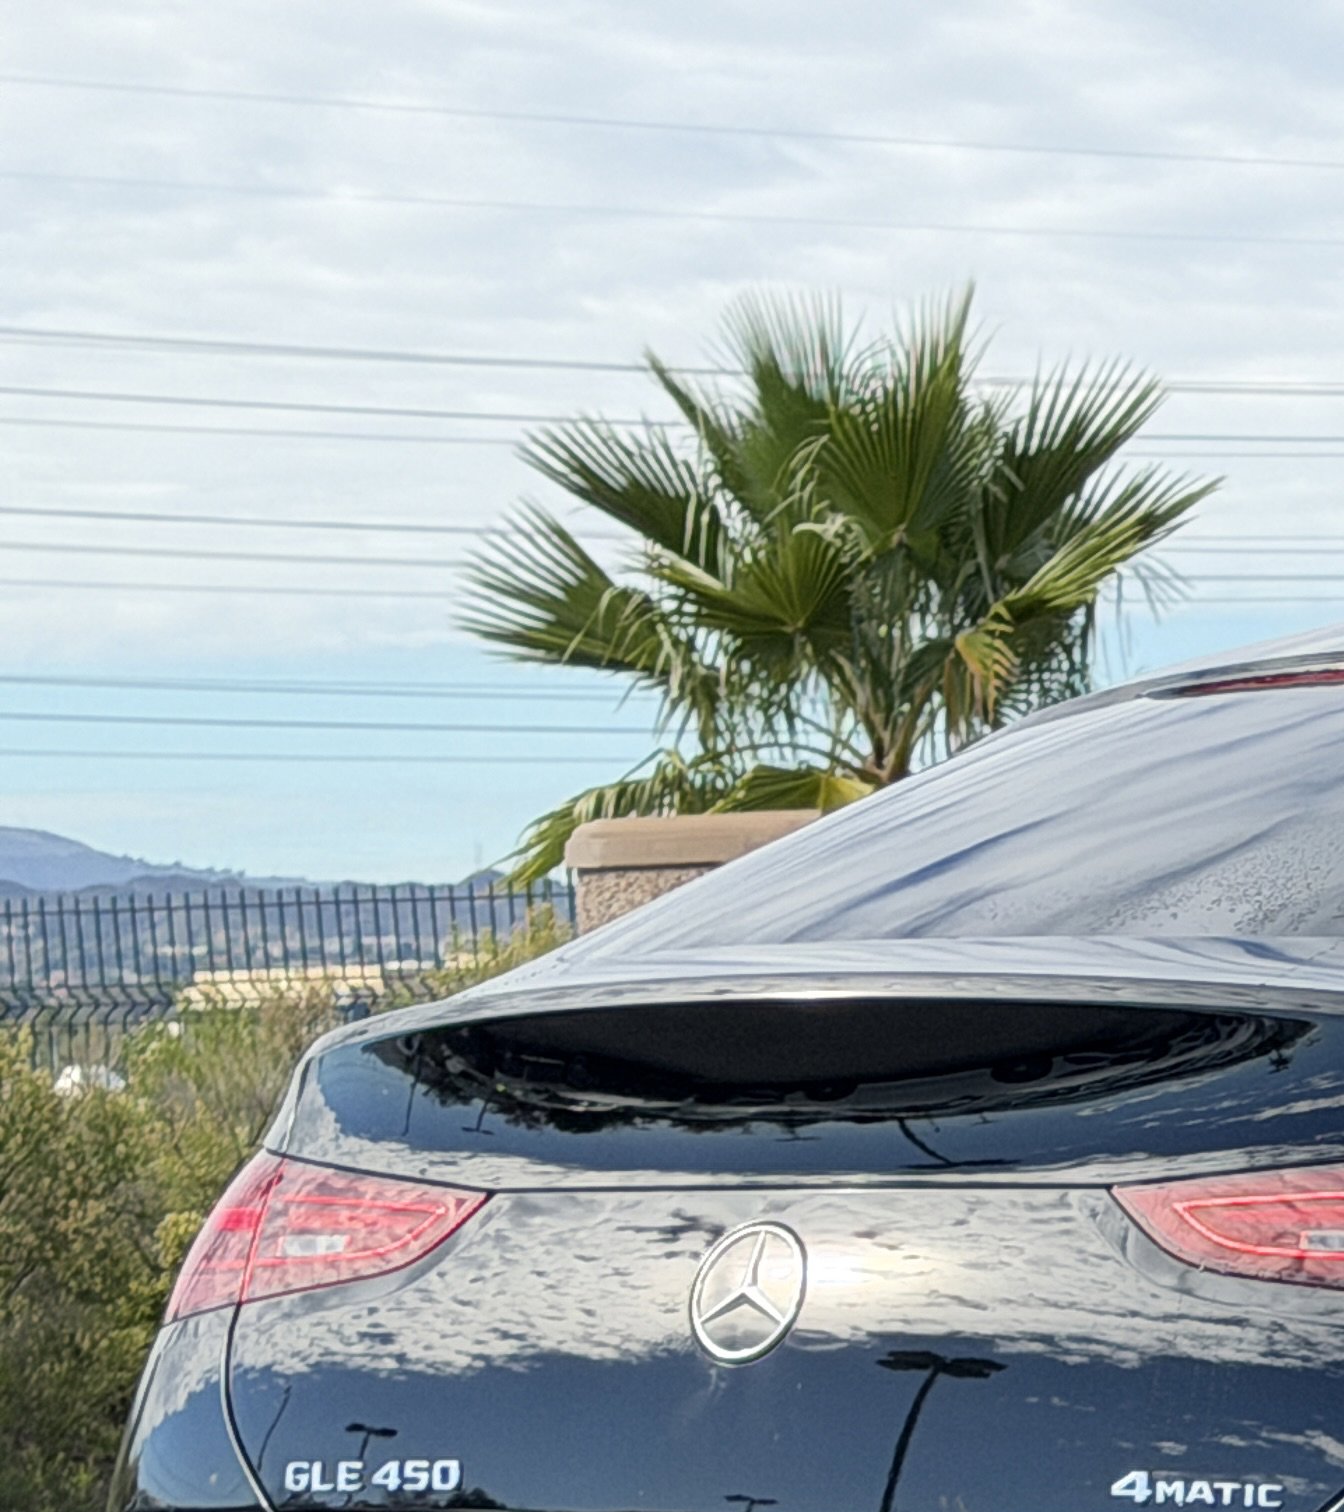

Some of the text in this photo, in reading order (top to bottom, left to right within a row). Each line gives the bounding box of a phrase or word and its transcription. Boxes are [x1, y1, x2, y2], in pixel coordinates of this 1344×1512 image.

[285, 1459, 460, 1492] GLE 450
[1111, 1470, 1284, 1508] 4MATIC
